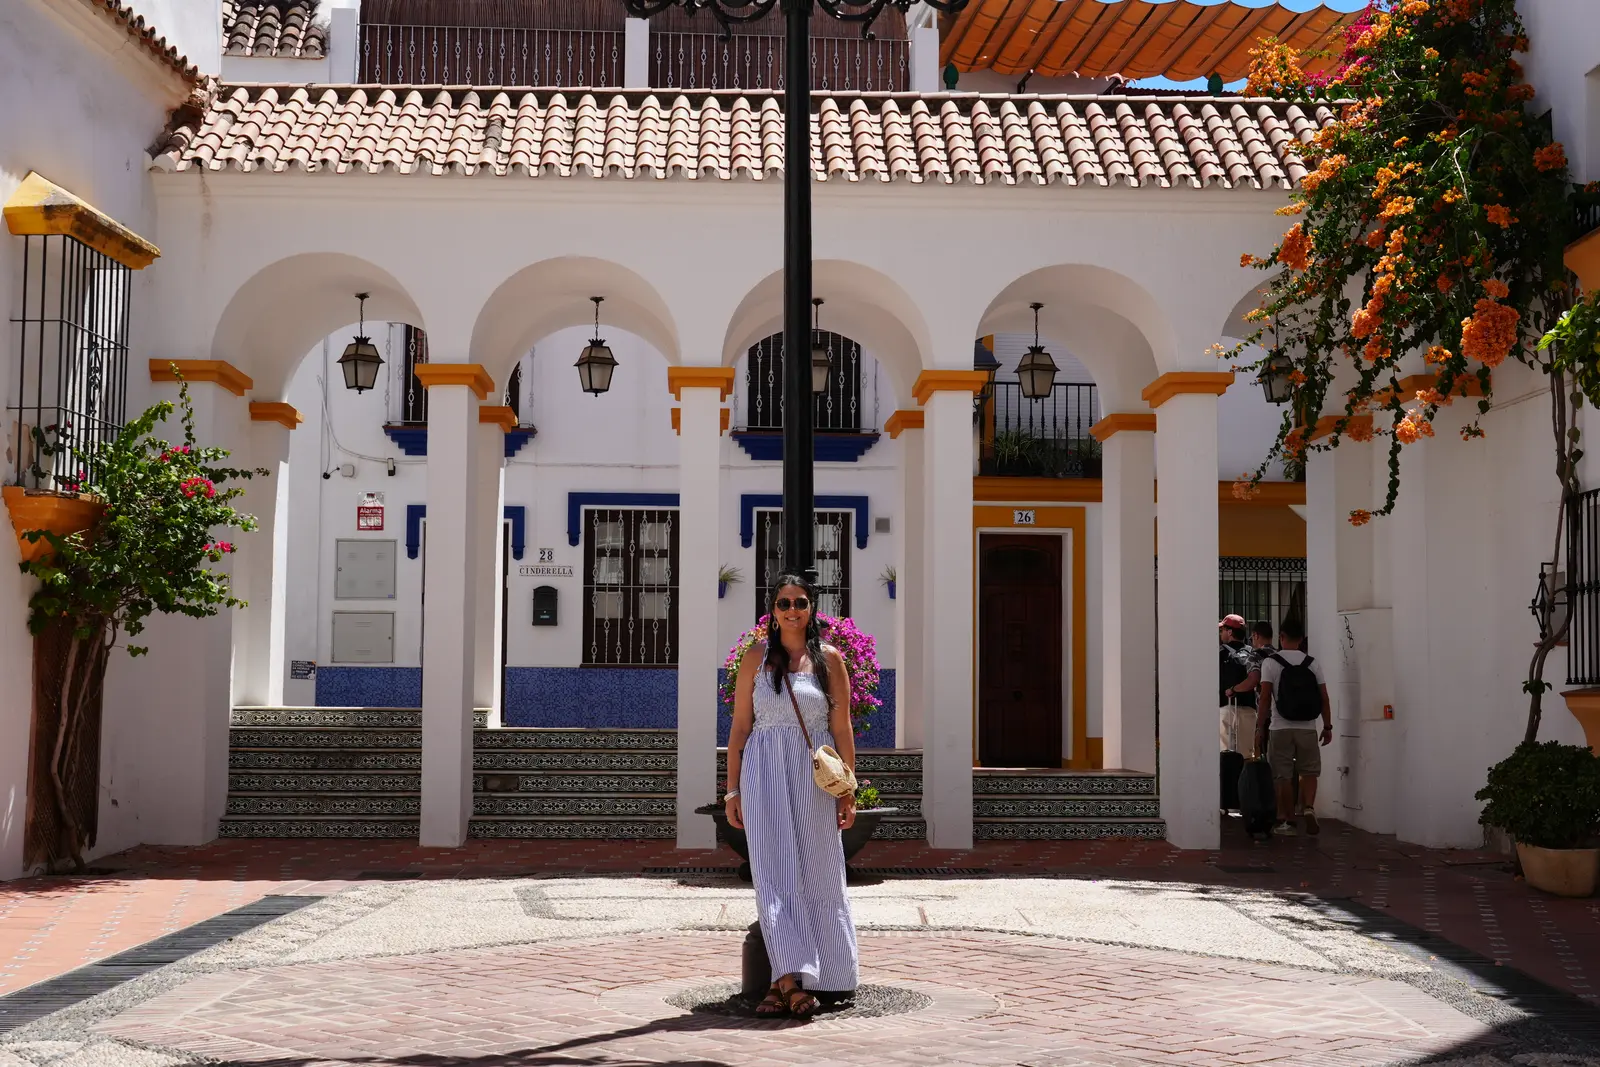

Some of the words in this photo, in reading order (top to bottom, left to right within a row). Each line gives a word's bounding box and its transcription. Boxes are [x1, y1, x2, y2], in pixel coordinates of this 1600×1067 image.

[1017, 511, 1031, 523] 26
[539, 550, 553, 561] 28
[519, 567, 573, 575] CINDERELLA
